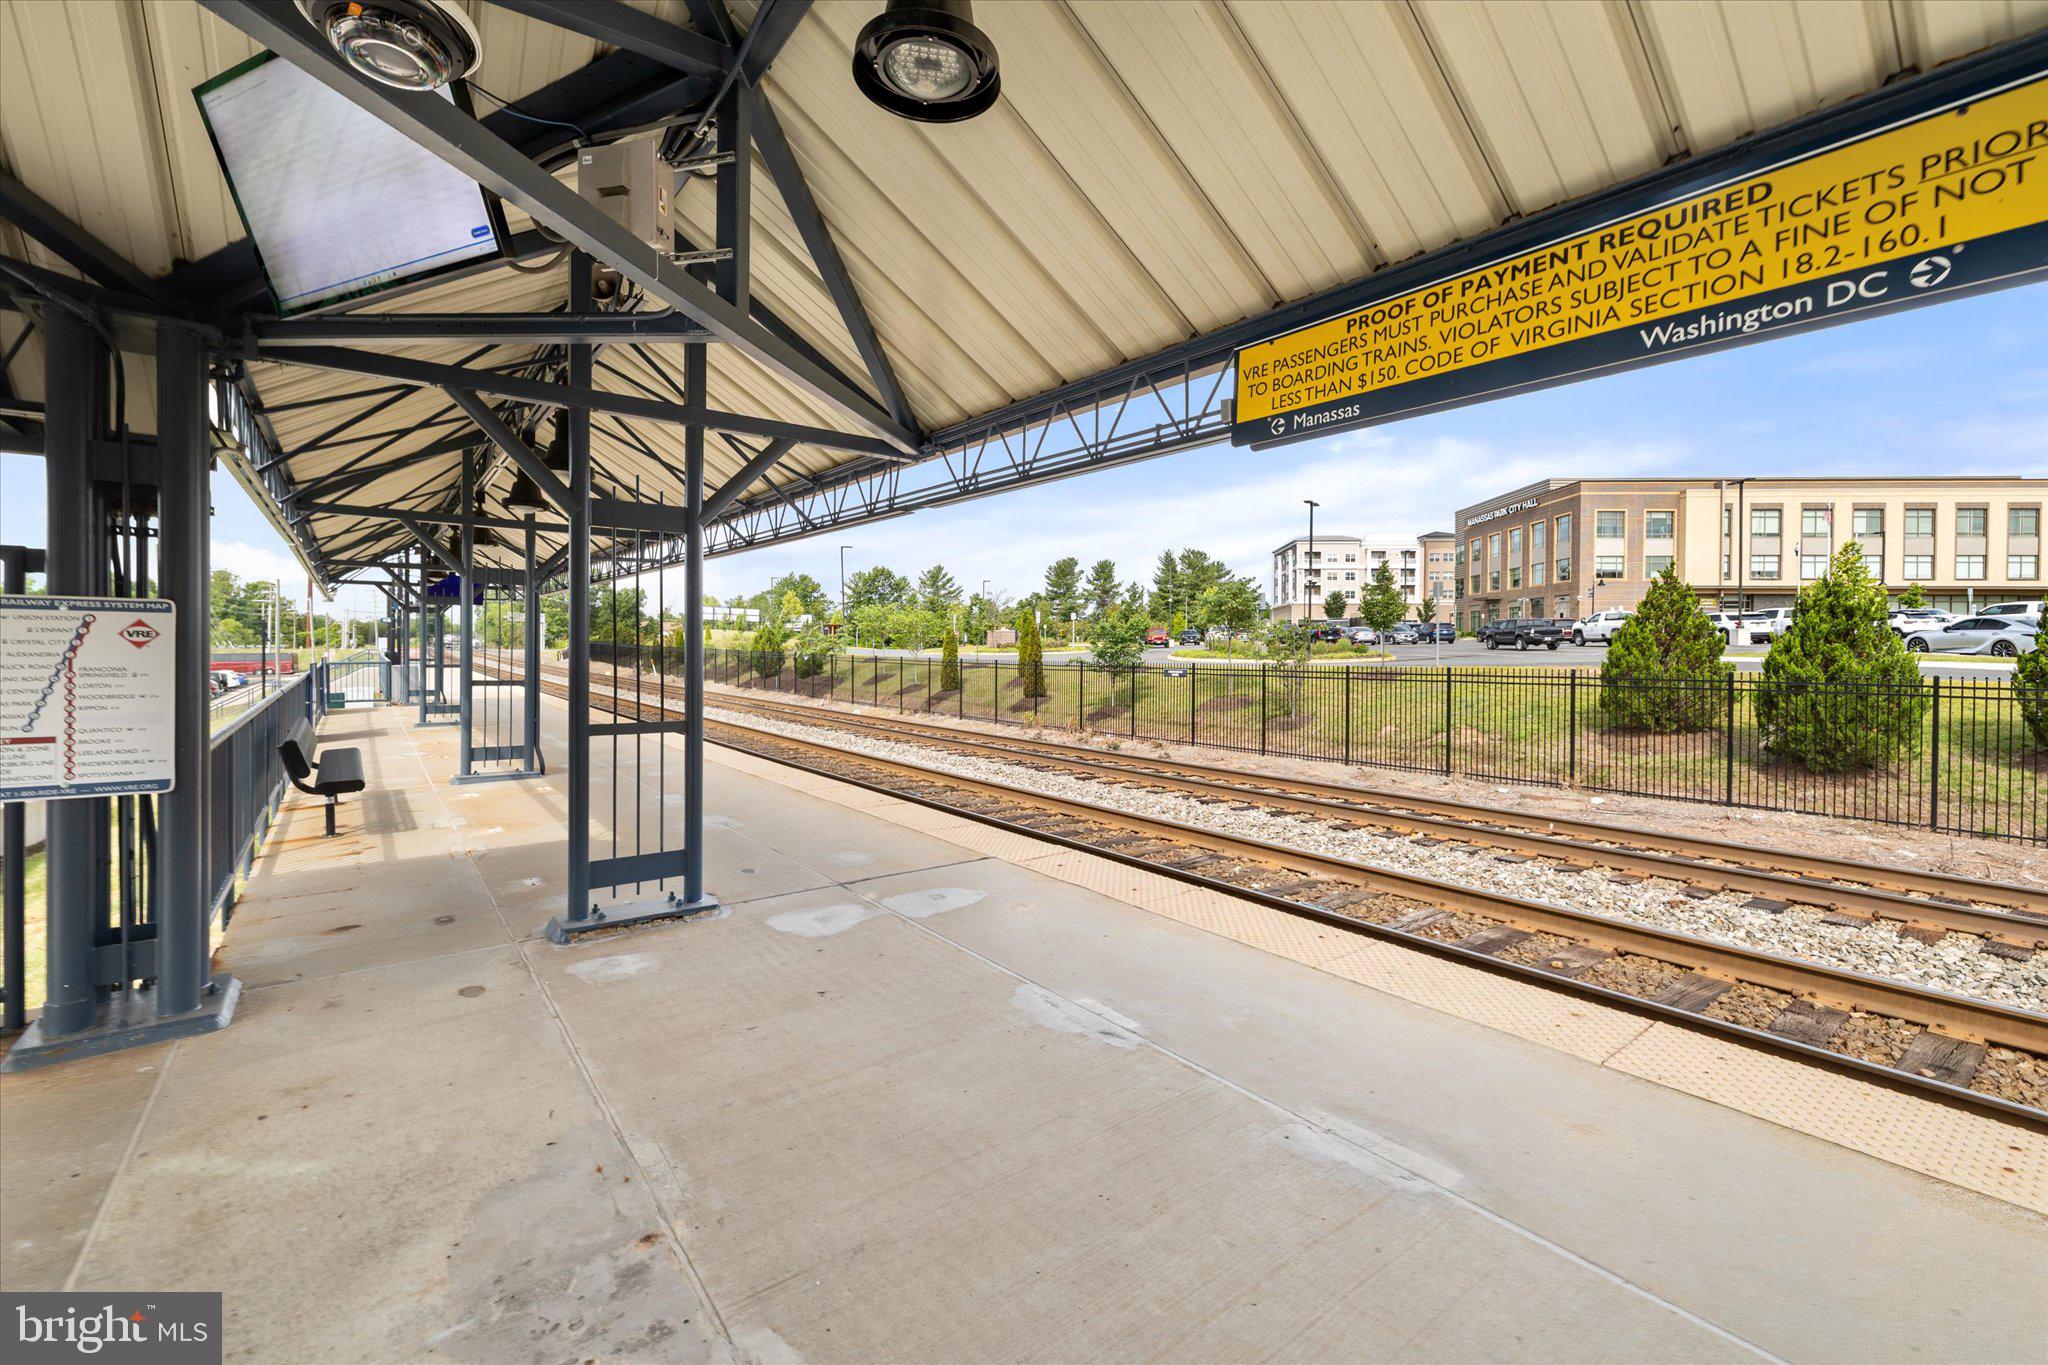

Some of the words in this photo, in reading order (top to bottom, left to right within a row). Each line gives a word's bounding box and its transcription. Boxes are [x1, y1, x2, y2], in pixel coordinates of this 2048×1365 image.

[1243, 359, 1269, 382] VRE
[1273, 333, 1368, 373] PASSENGERS
[1374, 314, 1423, 344] MUST
[1430, 280, 1543, 327] PURCHASE
[1549, 258, 1607, 292] AND
[1614, 214, 1749, 269] VALIDATE
[1758, 164, 1904, 231] TICKETS
[1921, 119, 2048, 180] PRIOR
[1248, 381, 1267, 399] TO
[1272, 356, 1358, 393] BOARDING
[1363, 336, 1432, 367] TRAINS.
[1440, 296, 1562, 344] VIOLATORS
[1570, 260, 1680, 309] SUBJECT
[1687, 247, 1731, 275] TO
[1738, 241, 1763, 262] A
[1775, 210, 1851, 252] FINE
[1865, 194, 1918, 226] OF
[1934, 157, 2035, 206] NOT
[1347, 300, 1416, 333] PROOF
[1423, 285, 1454, 309] OF
[1461, 240, 1591, 298] PAYMENT
[1600, 182, 1773, 253] REQUIRED
[1271, 385, 1302, 411] LESS
[1305, 375, 1352, 401] THAN
[1357, 364, 1400, 390] $150.
[1406, 346, 1463, 376] CODE
[1471, 338, 1500, 359] OF
[1511, 309, 1620, 349] VIRGINIA
[1630, 266, 1764, 319] SECTION
[1641, 292, 1812, 348] Washington
[1826, 272, 1888, 308] DC
[1293, 405, 1360, 430] Manassas
[1467, 511, 1494, 526] MANASSAS
[1494, 508, 1508, 518] PARK
[1509, 503, 1521, 514] CITY
[1522, 498, 1538, 510] HALL
[126, 630, 153, 638] VRE
